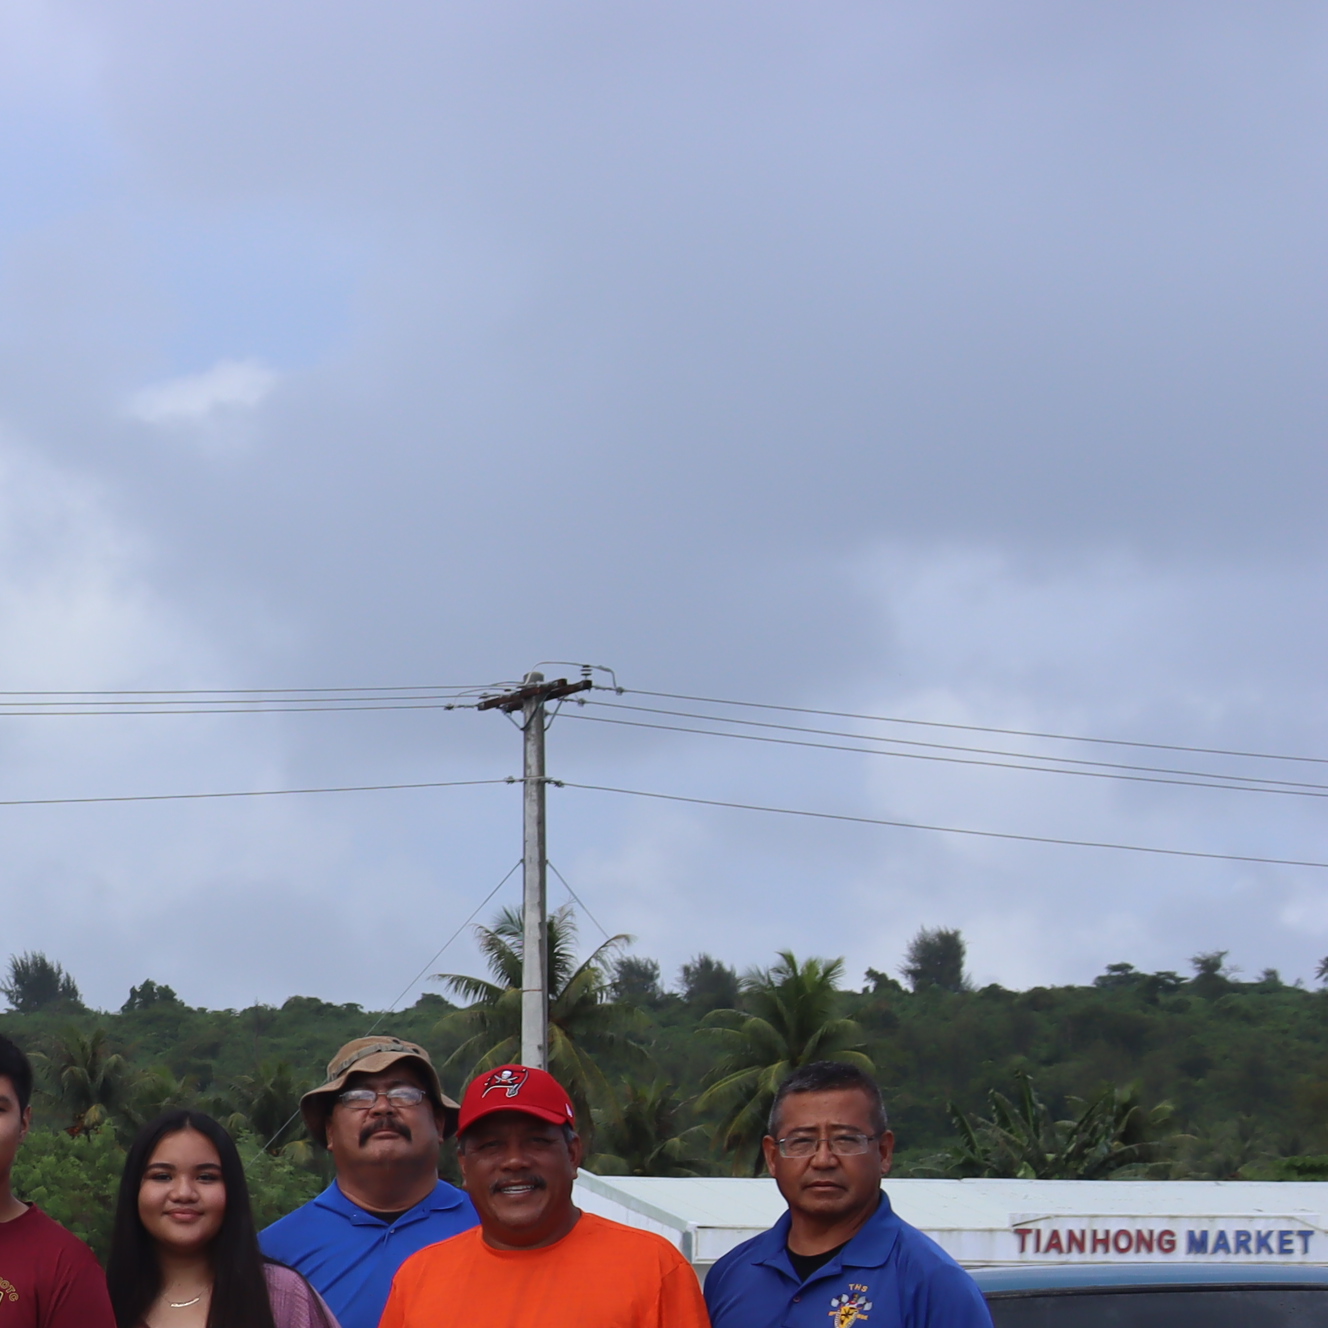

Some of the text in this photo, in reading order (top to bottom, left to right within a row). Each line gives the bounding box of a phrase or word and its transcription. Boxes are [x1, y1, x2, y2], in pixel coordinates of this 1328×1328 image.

[1013, 1228, 1315, 1255] TIANHONG MARKET
[848, 1283, 869, 1293] THS
